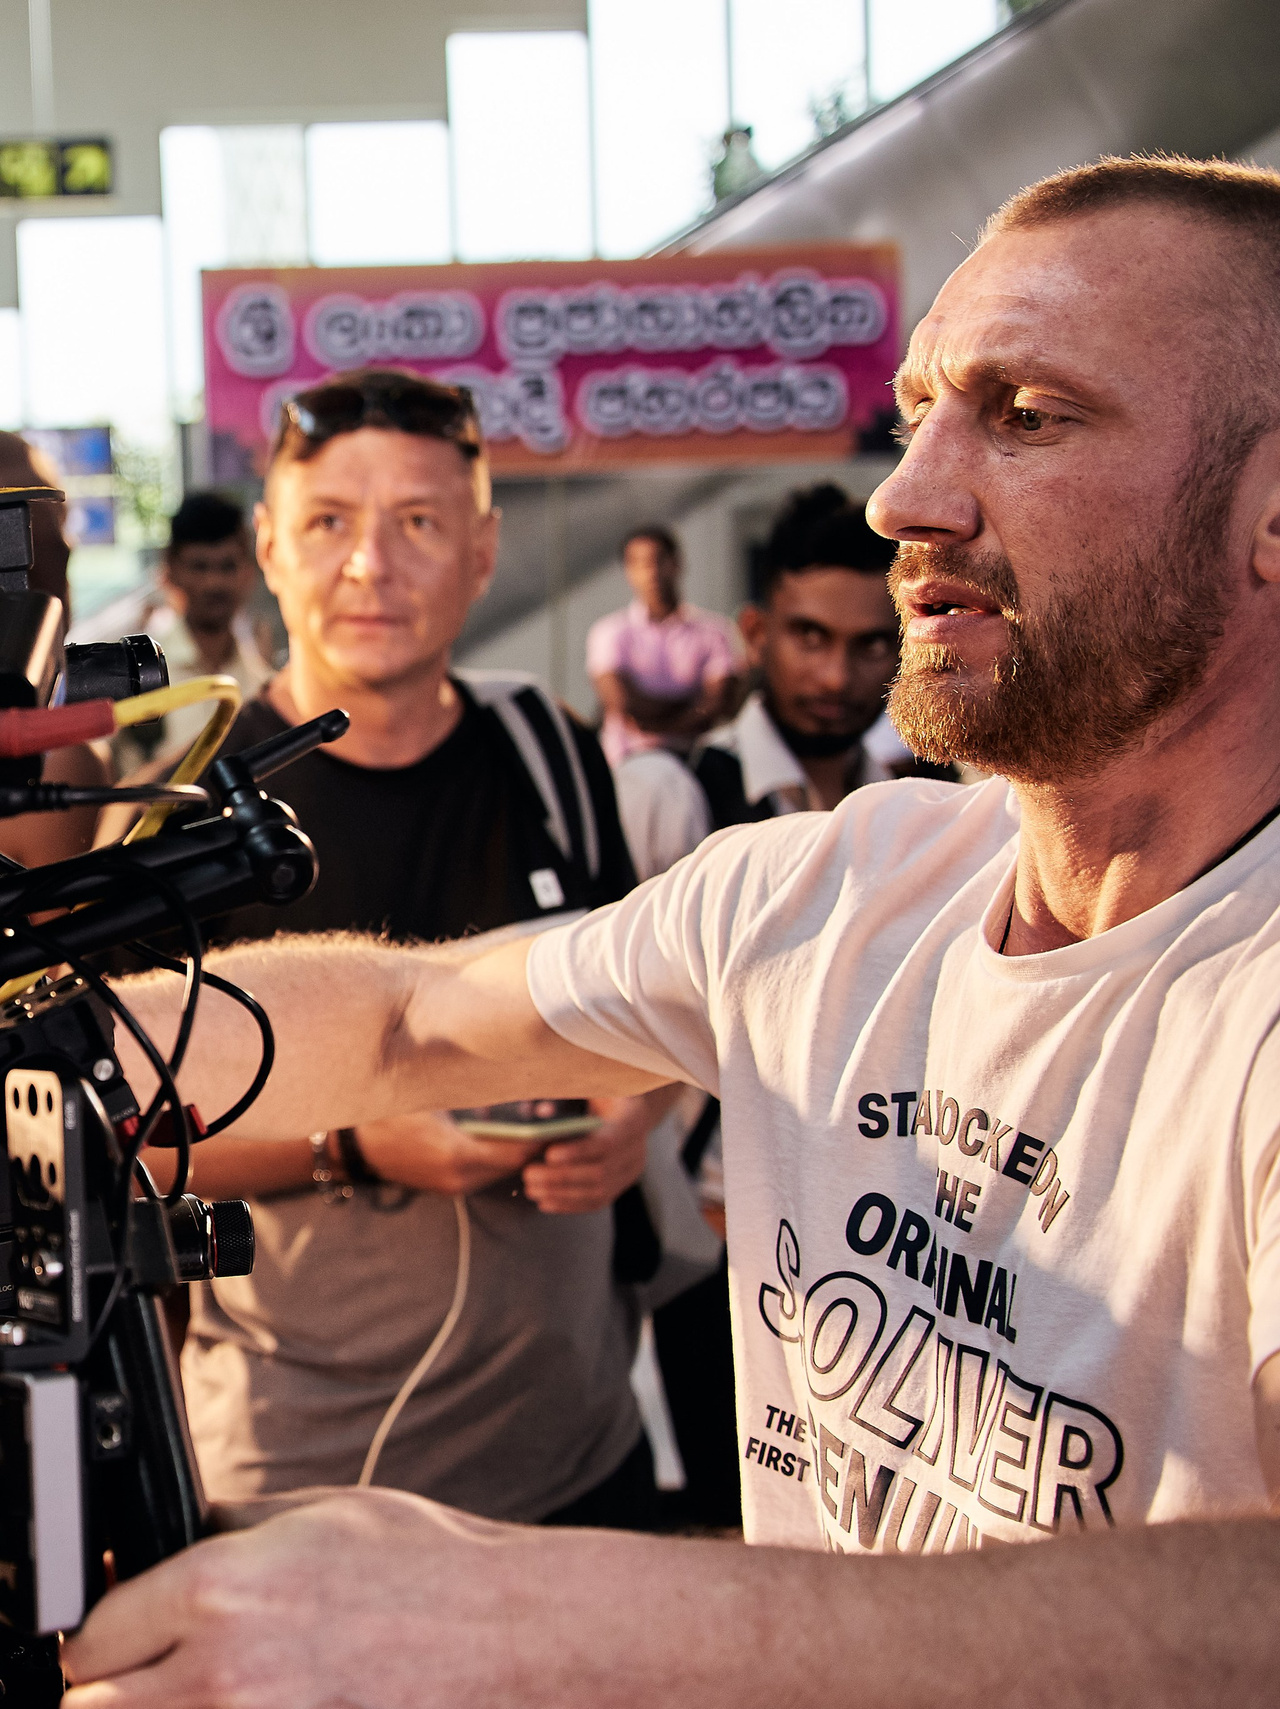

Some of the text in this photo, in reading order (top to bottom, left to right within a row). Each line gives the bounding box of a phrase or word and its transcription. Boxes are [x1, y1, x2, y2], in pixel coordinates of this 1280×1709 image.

[934, 1167, 981, 1233] HE
[765, 1404, 807, 1443] THE
[744, 1436, 811, 1482] FIRST
